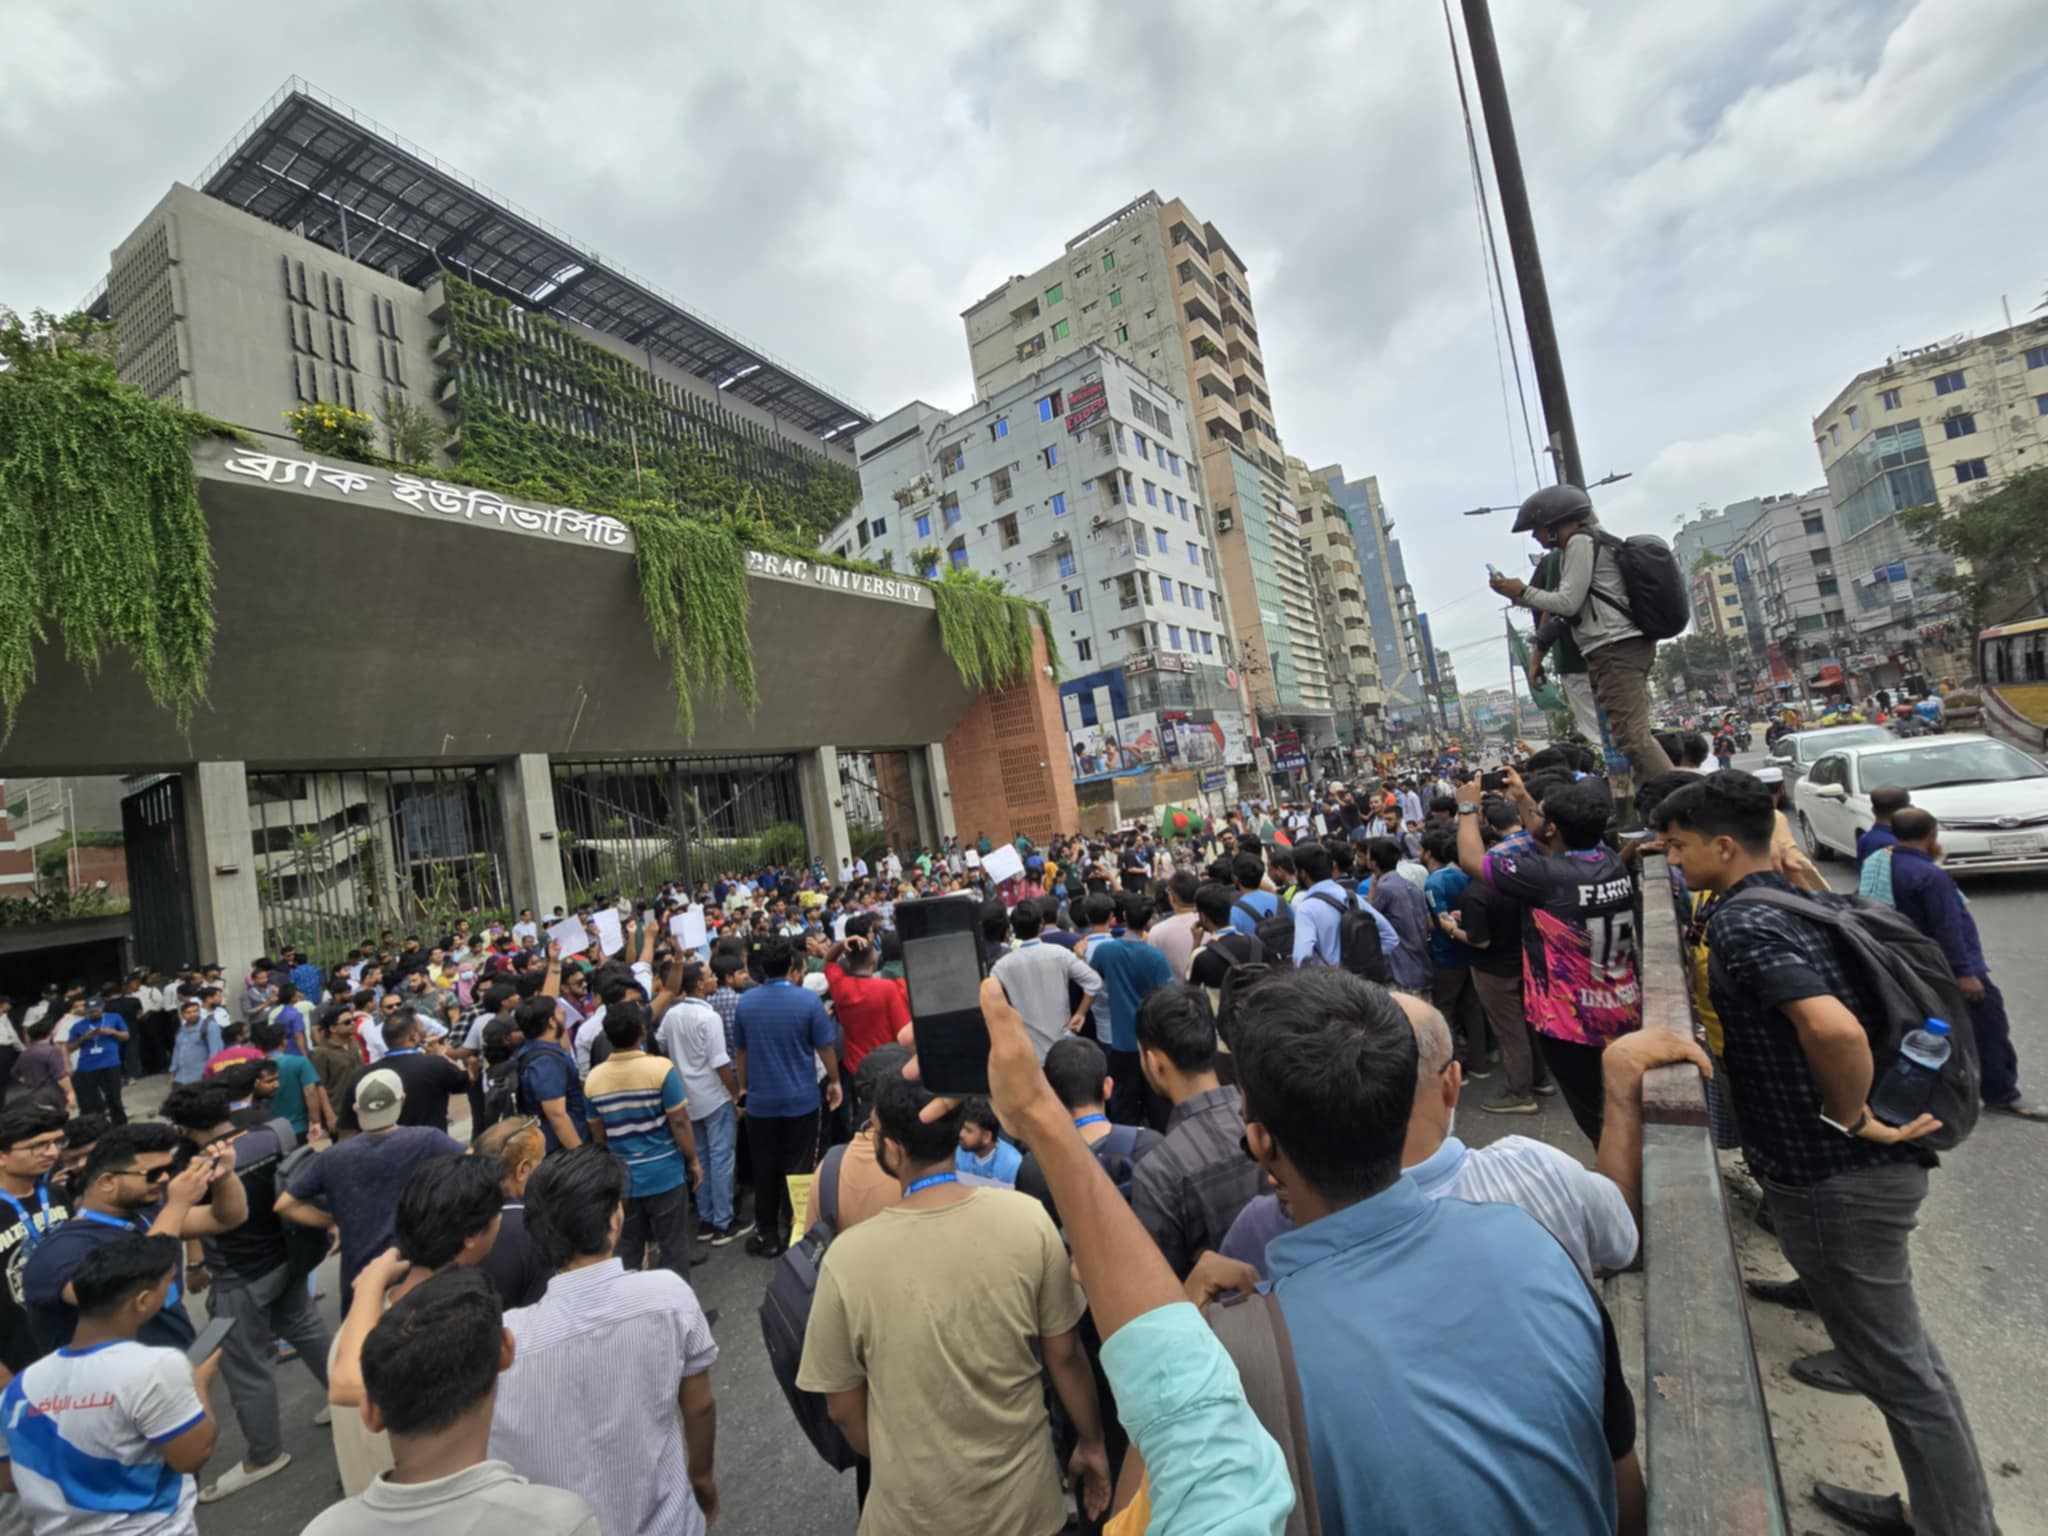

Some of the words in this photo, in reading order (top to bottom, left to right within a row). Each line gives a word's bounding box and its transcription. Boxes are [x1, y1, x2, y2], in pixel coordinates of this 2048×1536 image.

[224, 447, 376, 494] ব্র্যাক
[388, 472, 630, 546] ইউনিভার্সিটি
[749, 550, 809, 580] BRAC
[814, 565, 922, 602] UNIVERSITY
